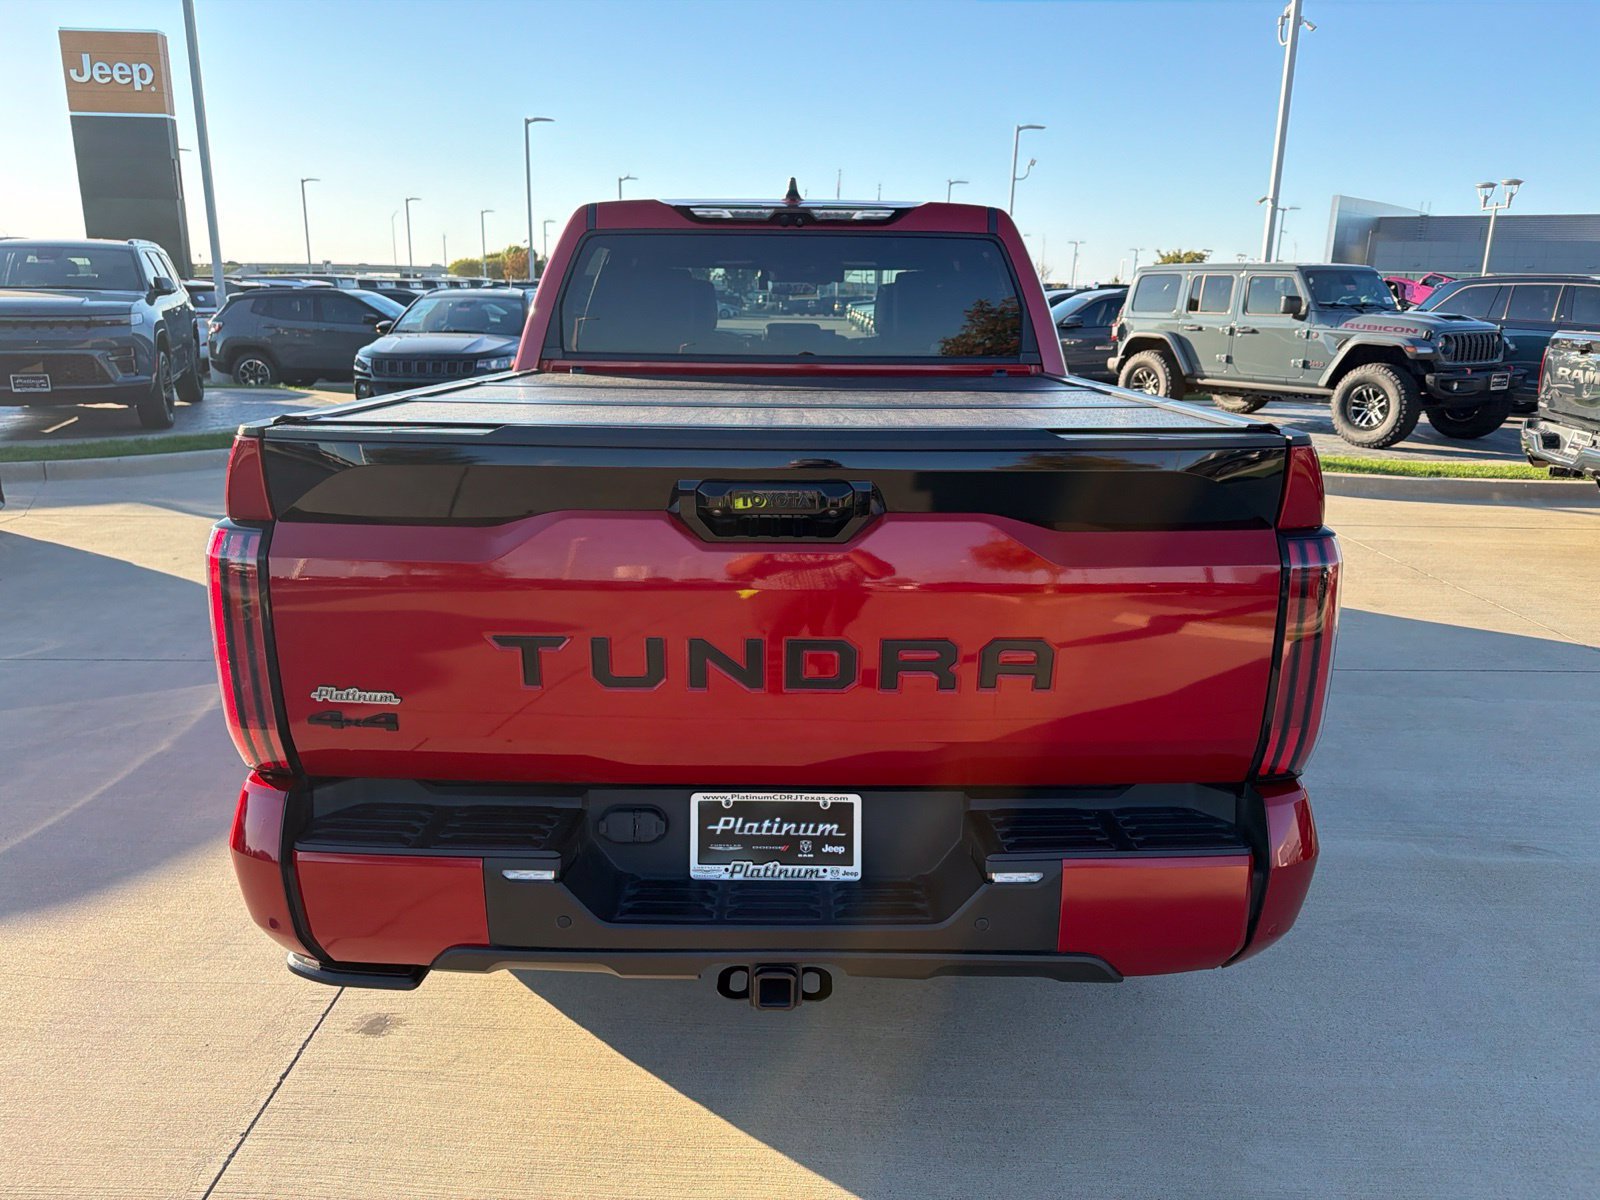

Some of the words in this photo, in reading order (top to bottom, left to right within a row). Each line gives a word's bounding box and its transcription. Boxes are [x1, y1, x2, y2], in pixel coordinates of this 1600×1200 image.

[1343, 322, 1419, 335] RUBICON
[741, 492, 810, 508] TOYOTA
[484, 635, 1058, 693] TUNDRA
[311, 686, 401, 705] Platinum
[702, 793, 849, 802] www.PlatinumCDRJTexas.com
[707, 817, 846, 836] Platinum
[822, 844, 845, 854] Jeep
[728, 862, 827, 879] Platinum
[841, 870, 859, 878] Jeep
